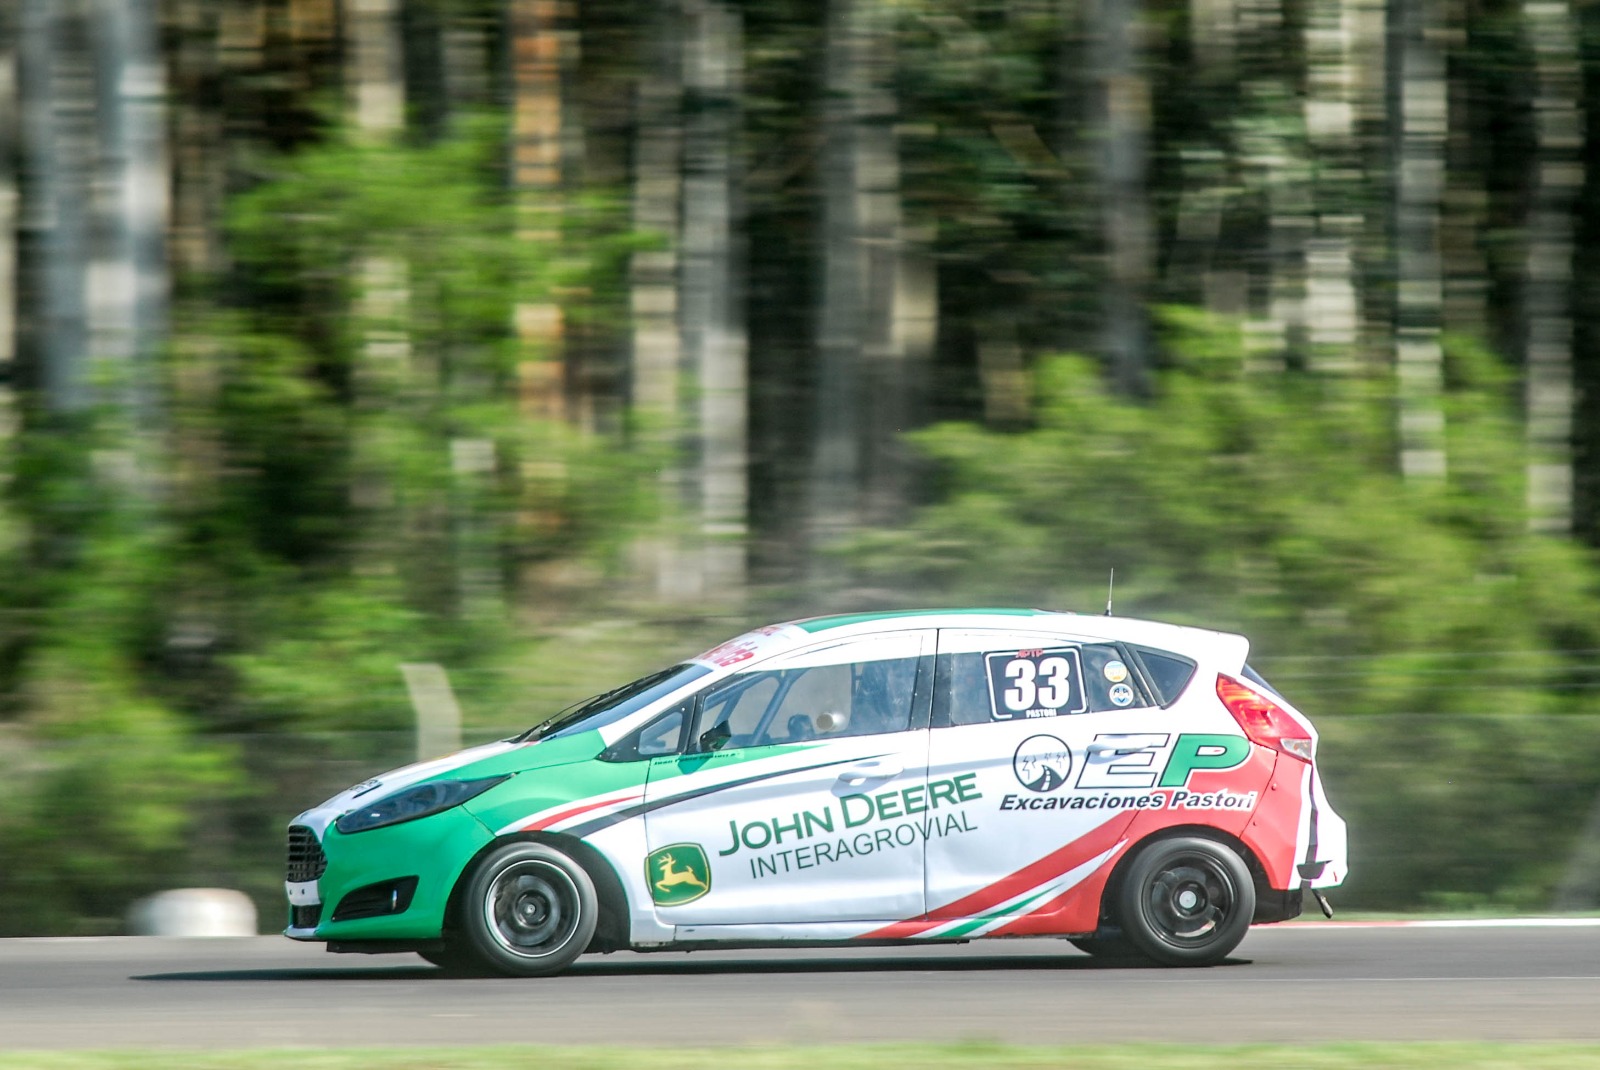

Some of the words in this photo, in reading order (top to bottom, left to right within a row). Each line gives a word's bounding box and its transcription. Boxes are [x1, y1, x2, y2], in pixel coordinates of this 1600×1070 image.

[1004, 657, 1070, 711] 33
[1025, 708, 1057, 718] PASTORI
[1075, 733, 1251, 789] EP
[719, 806, 834, 857] JOHN
[839, 772, 983, 829] DEERE
[1000, 793, 1163, 811] Excavaciones
[1171, 791, 1255, 809] Pastori
[750, 810, 978, 879] INTERAGROVIAL
